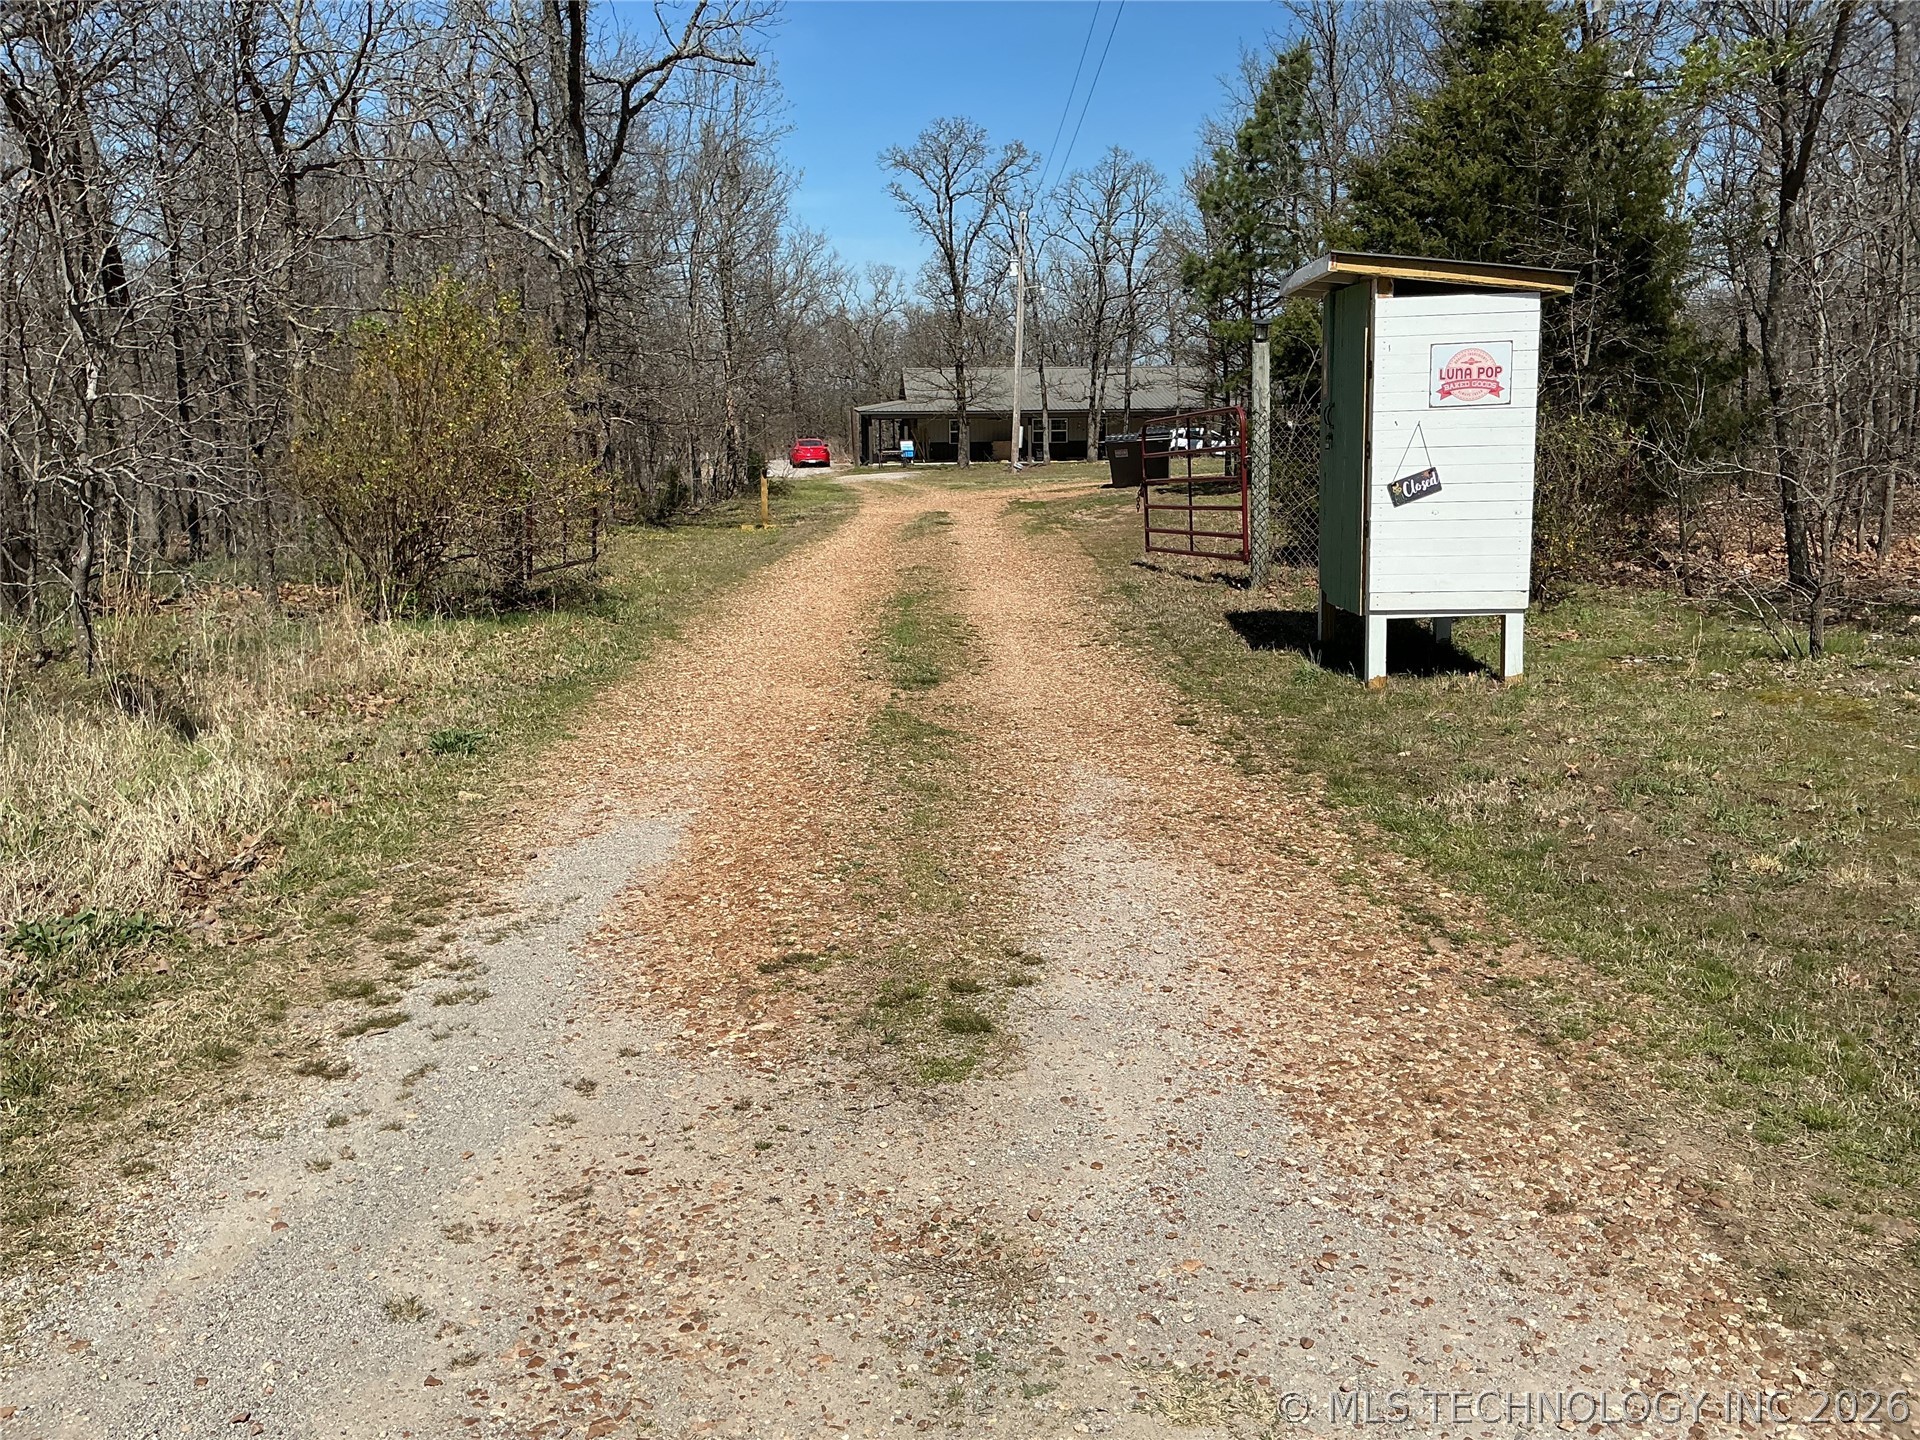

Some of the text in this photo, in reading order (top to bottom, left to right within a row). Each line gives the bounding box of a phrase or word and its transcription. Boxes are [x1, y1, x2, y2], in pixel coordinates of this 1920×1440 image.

[1439, 366, 1503, 380] LUNA POP
[1444, 380, 1497, 391] BAKED GOODS
[1402, 471, 1439, 498] Closed
